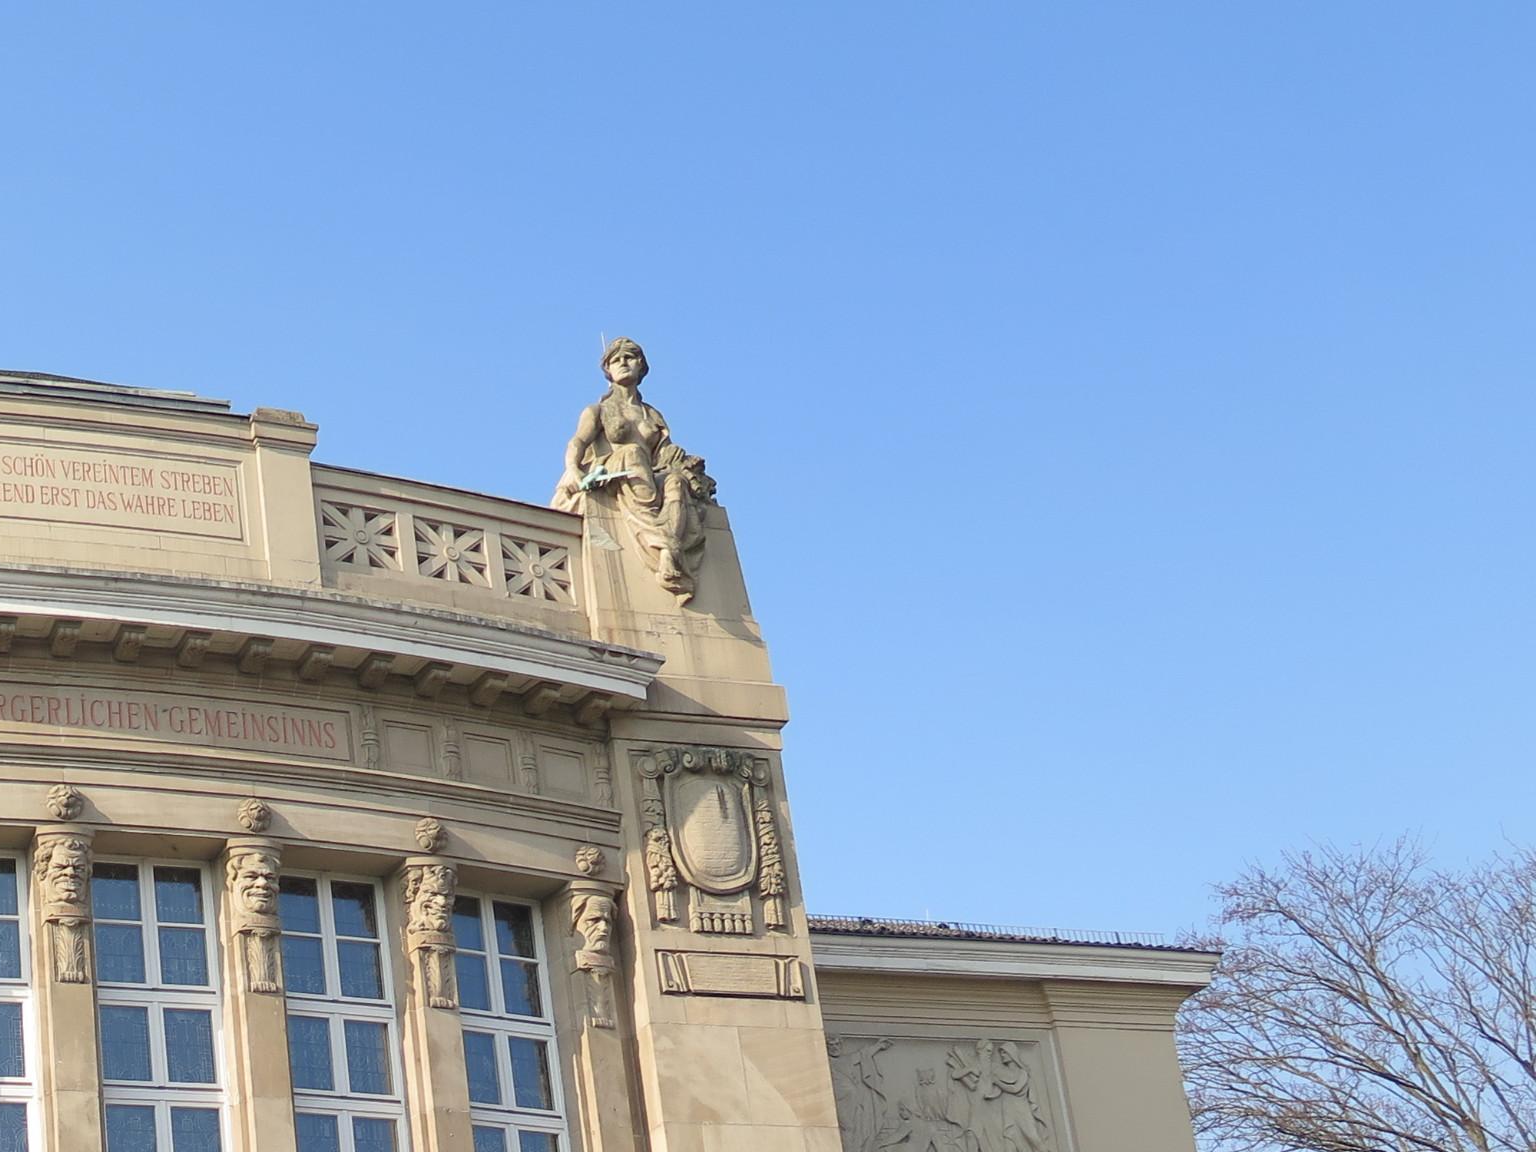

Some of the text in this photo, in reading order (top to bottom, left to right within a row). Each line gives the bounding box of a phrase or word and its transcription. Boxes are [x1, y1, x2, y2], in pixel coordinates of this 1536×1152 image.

[1, 453, 57, 479] SCHÖN
[59, 459, 154, 489] VEREINTEM
[159, 470, 235, 498] STREBEN
[40, 485, 81, 508] ERST
[85, 490, 118, 512] DAS
[120, 493, 178, 518] WAHRE
[181, 499, 235, 525] LEBEN
[168, 704, 338, 750] GEMEINSINNS
